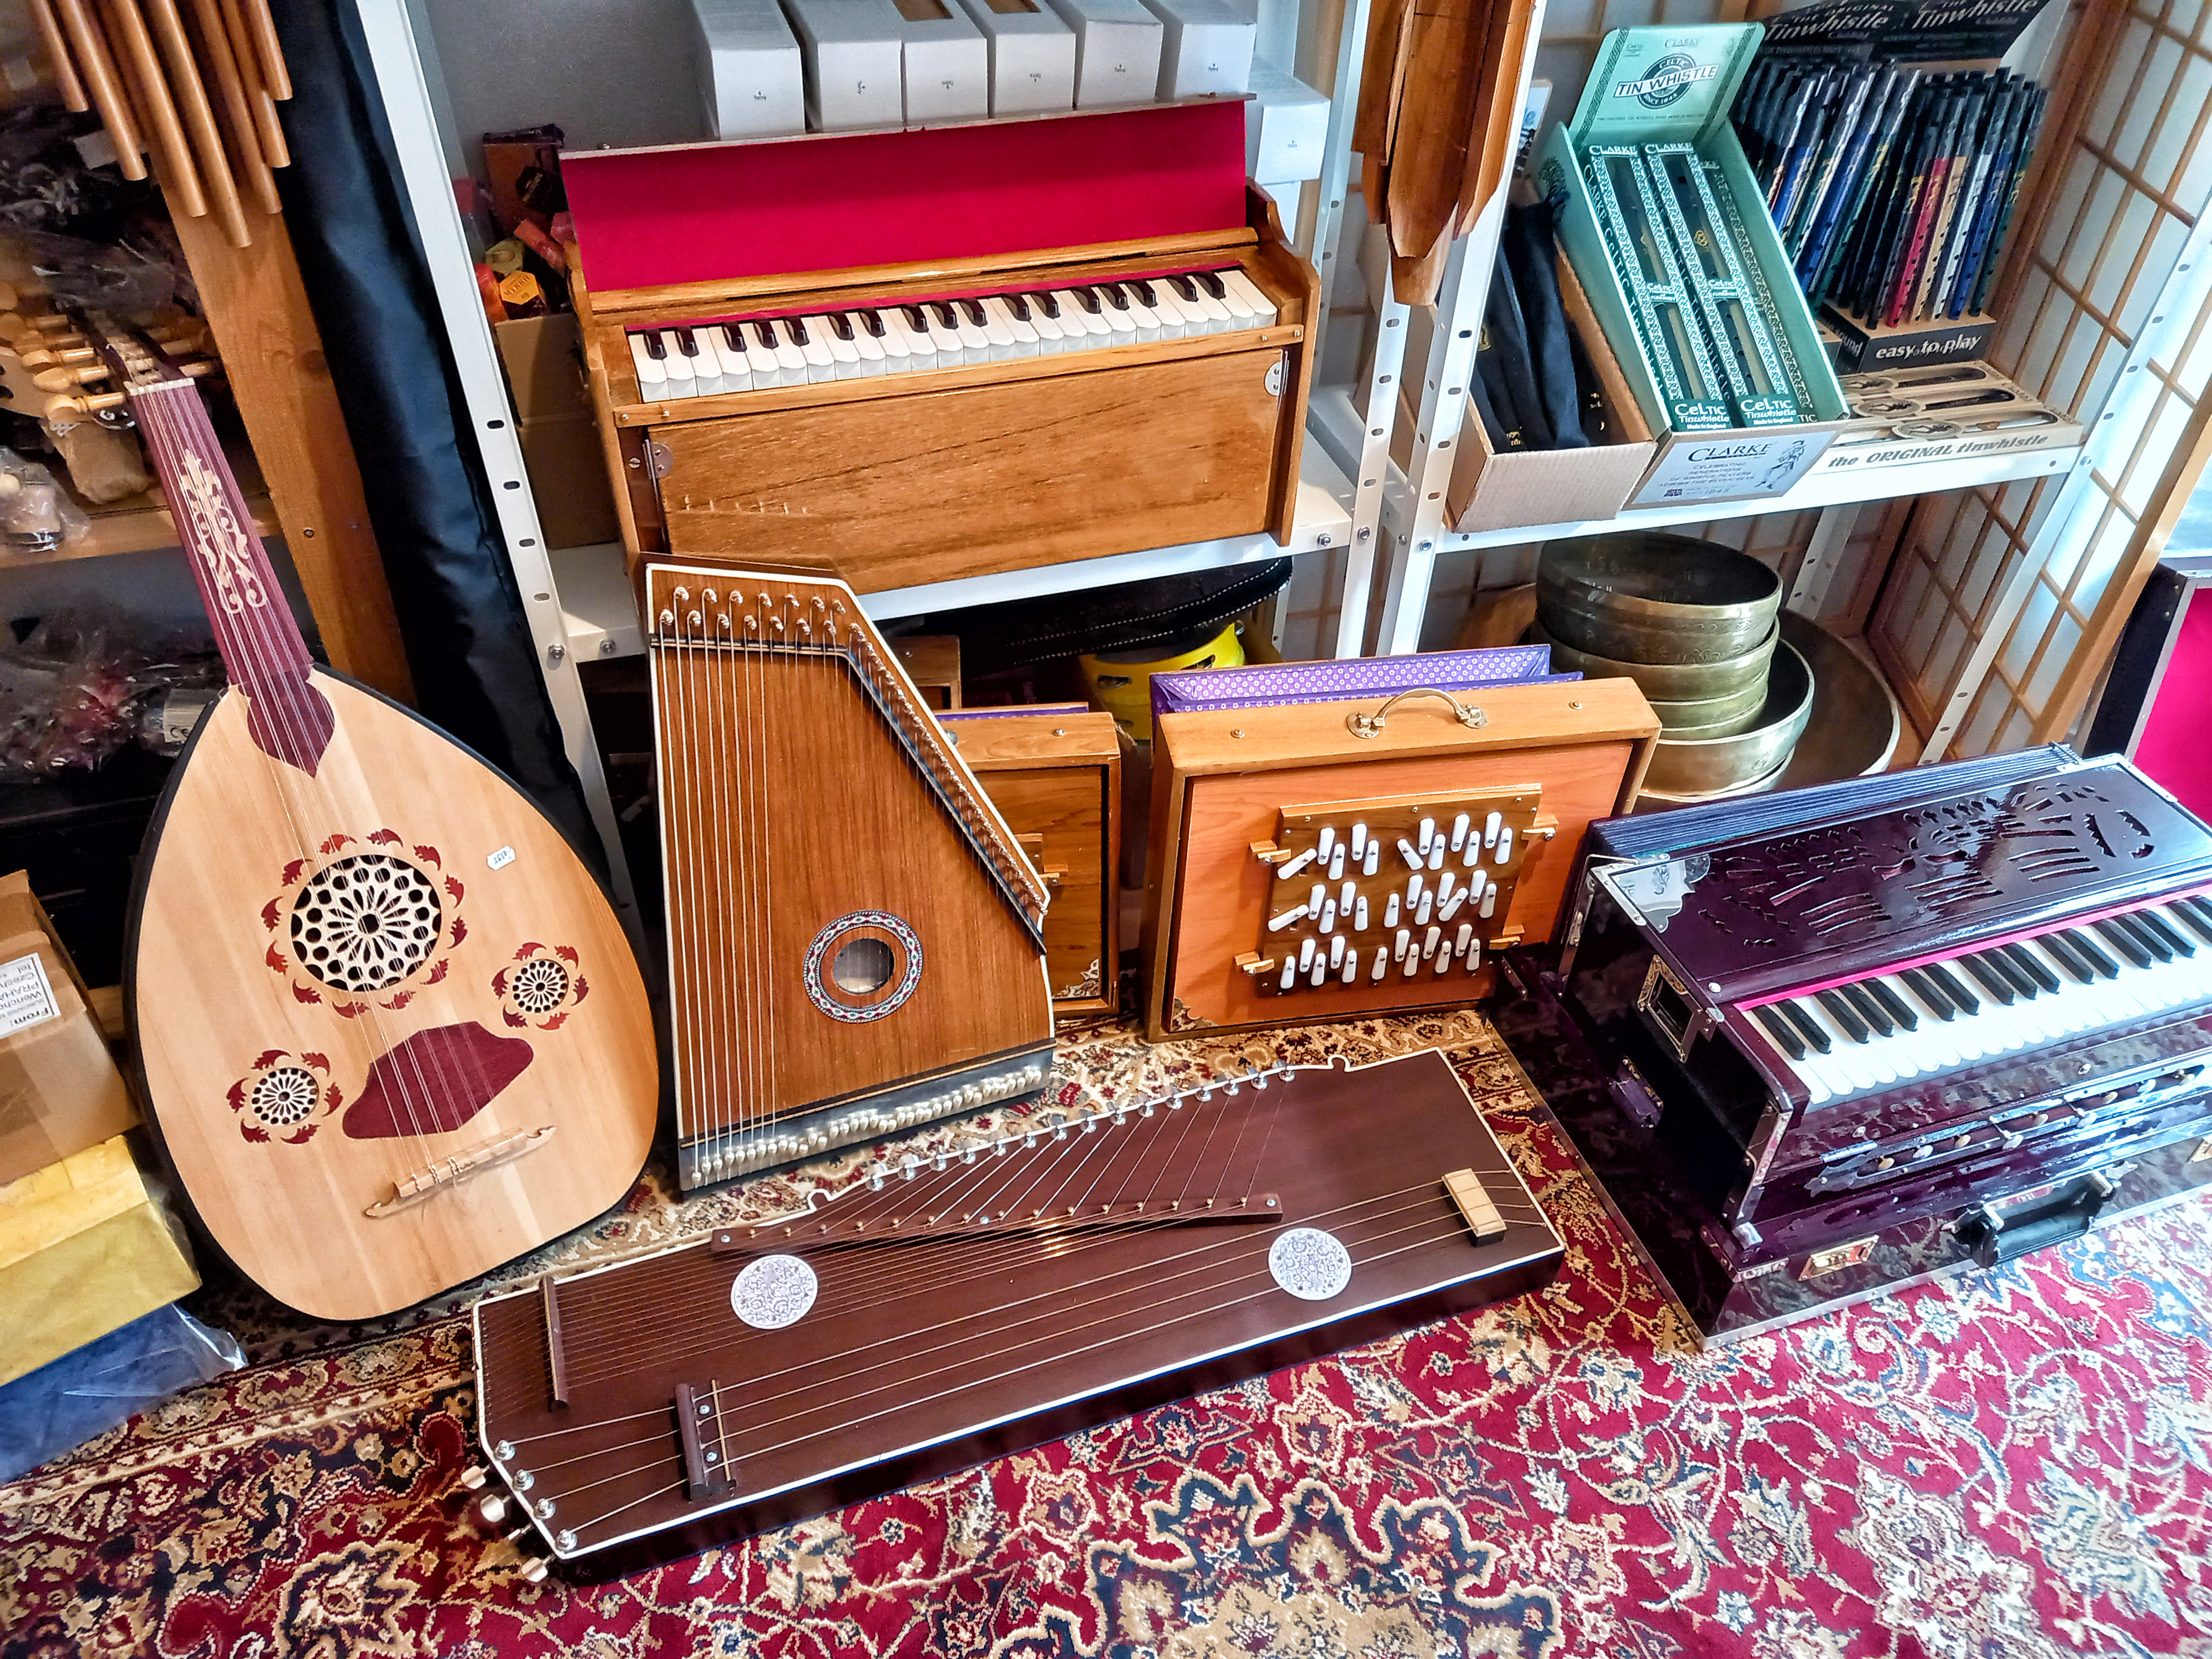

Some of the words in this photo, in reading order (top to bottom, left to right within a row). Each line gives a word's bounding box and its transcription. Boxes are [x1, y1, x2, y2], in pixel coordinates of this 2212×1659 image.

[1764, 11, 1889, 41] Tinwhistle
[1660, 58, 1688, 69] CELTIC
[1619, 83, 1643, 95] TIN
[1650, 65, 1718, 90] WHISTLE
[1589, 145, 1638, 155] CLARKE
[1645, 142, 1694, 155] CLARKE
[1583, 164, 1607, 223] CLARKE
[1875, 343, 1916, 360] easy
[1938, 333, 1983, 357] play
[1678, 415, 1730, 424] Tinwhistle
[1744, 409, 1797, 419] Tinwhistle
[1688, 443, 1772, 462] CLARKE
[1827, 457, 1859, 468] the
[1865, 444, 1953, 463] ORIGINAL
[1957, 435, 2048, 453] tinwhistle
